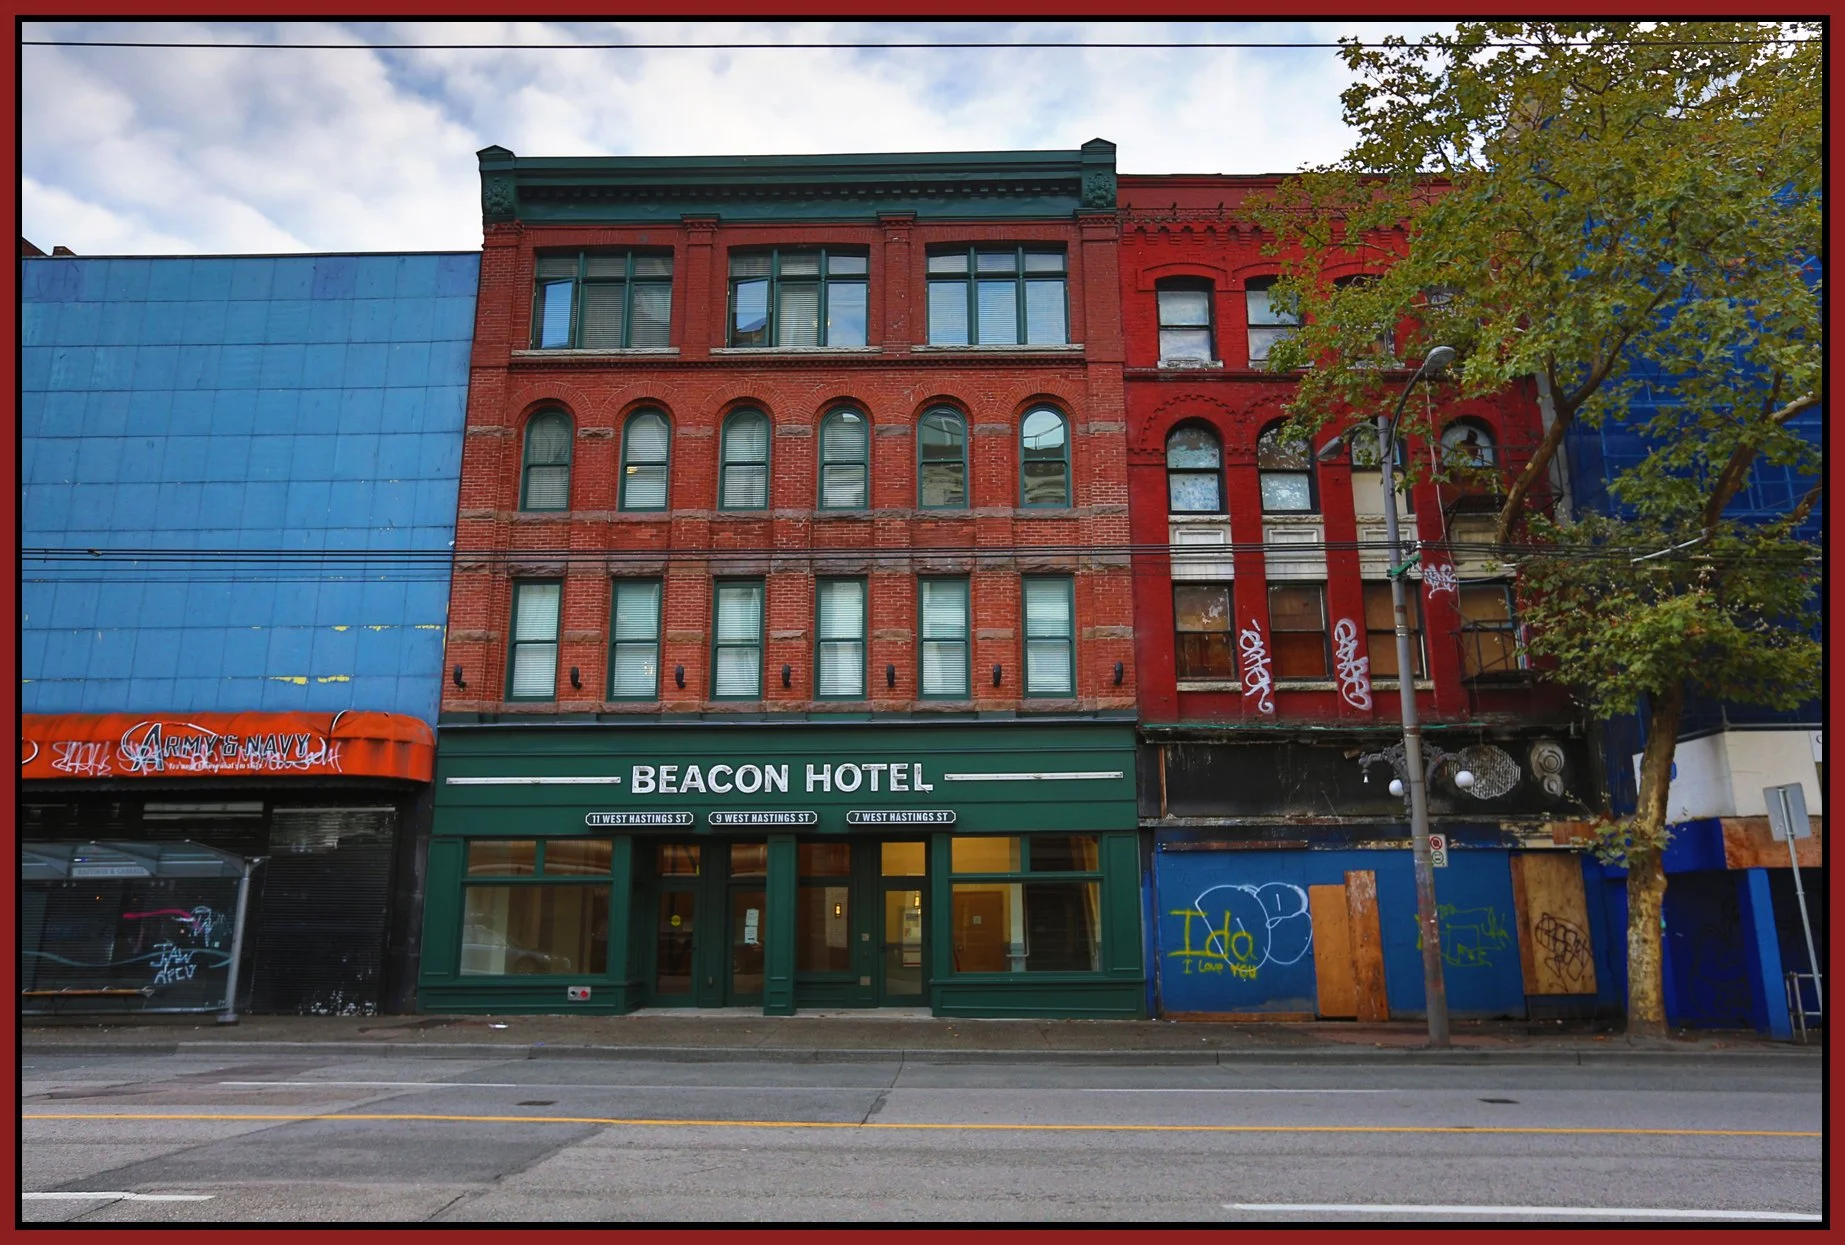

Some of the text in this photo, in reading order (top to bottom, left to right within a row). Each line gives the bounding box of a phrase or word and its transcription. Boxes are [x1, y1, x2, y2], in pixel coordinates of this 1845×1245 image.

[121, 722, 218, 772] ARMY
[223, 734, 239, 757] &
[244, 733, 311, 758] NAVY
[631, 763, 934, 794] BEACON HOTEL
[592, 813, 687, 824] 11 WEST HASTINGS ST
[716, 813, 811, 823] 9 WEST HASTINGS ST
[854, 812, 949, 822] 7 WEST HASTINGS ST
